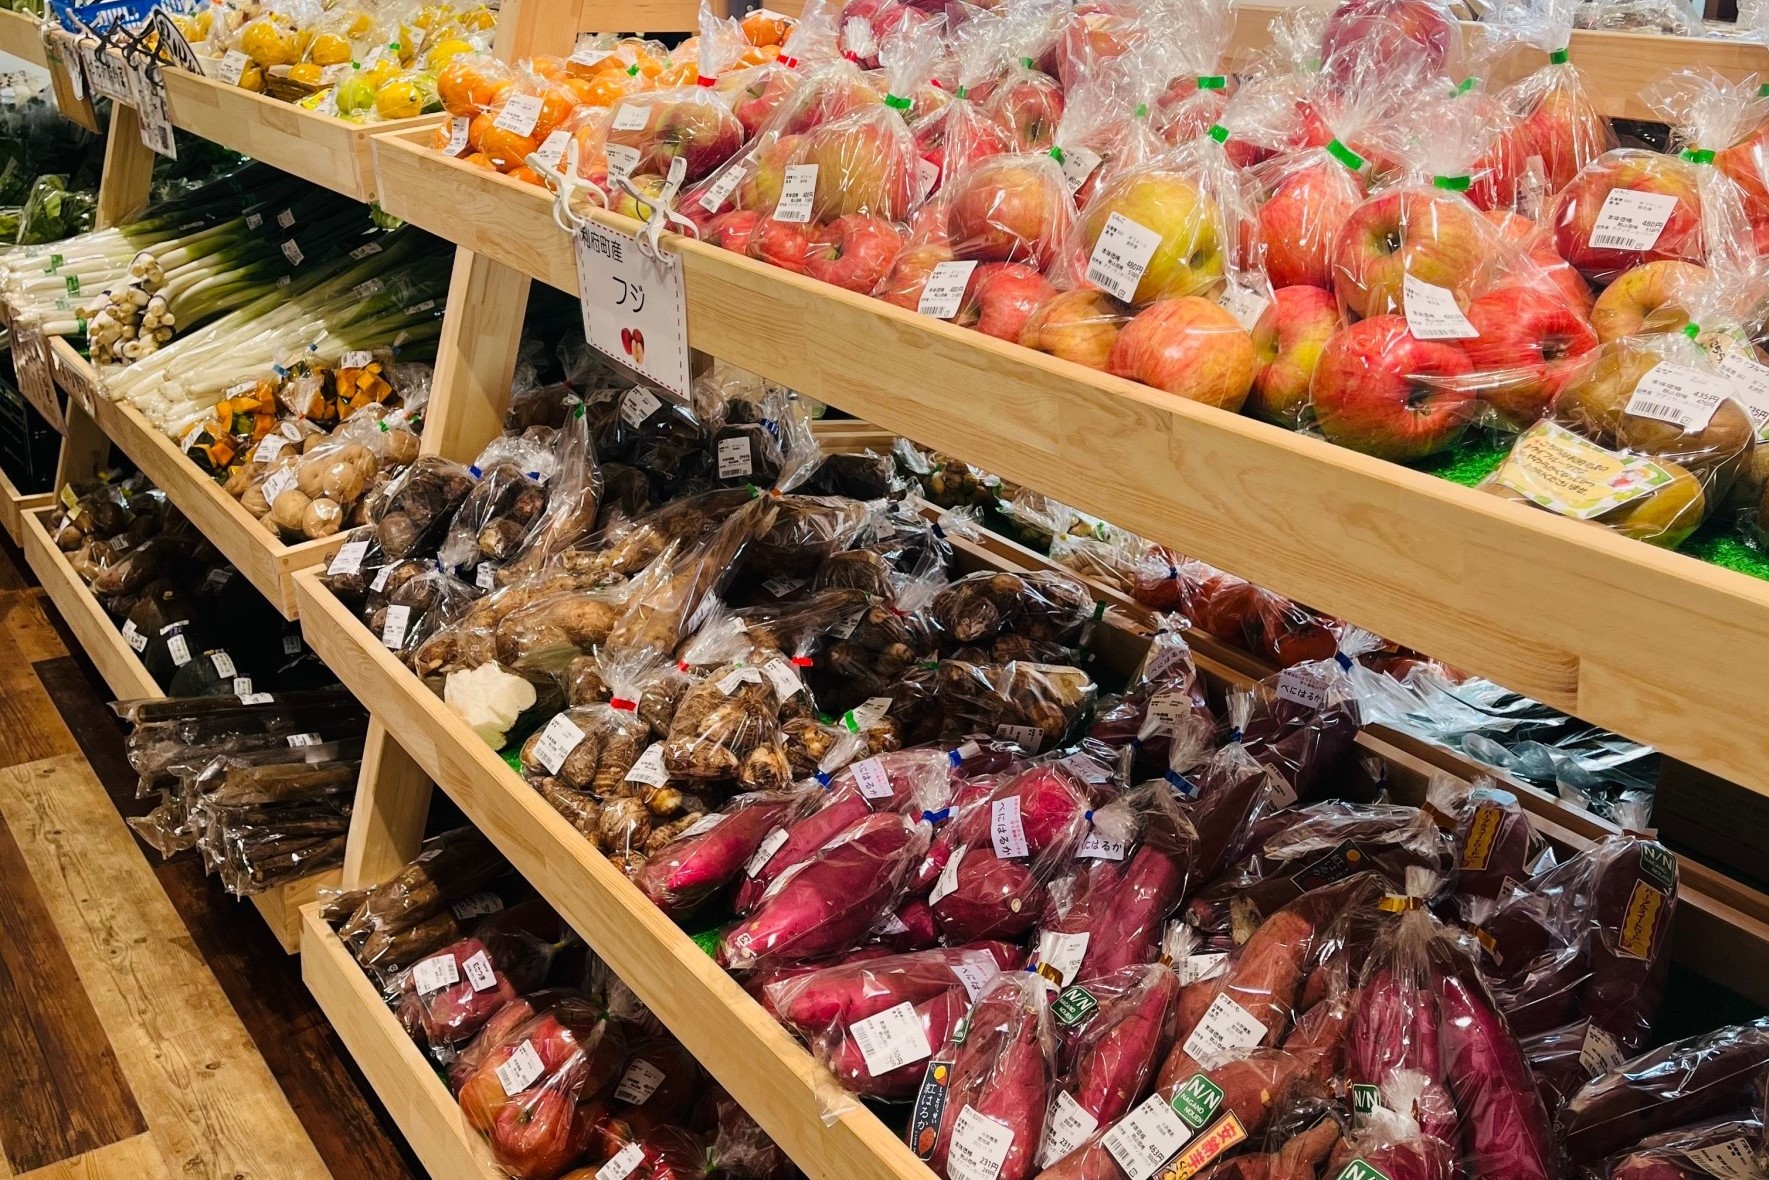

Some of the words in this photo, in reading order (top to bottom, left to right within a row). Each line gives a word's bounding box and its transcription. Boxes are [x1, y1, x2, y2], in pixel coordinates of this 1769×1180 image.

[1642, 220, 1663, 228] 480円
[581, 227, 623, 264] 利府町産
[1127, 260, 1144, 273] 480円
[612, 276, 645, 313] フジ
[1693, 391, 1720, 404] 435円
[1281, 684, 1321, 702] べにはるか
[997, 802, 1012, 856] べにはるか
[1066, 990, 1092, 1011] N/N
[1220, 995, 1240, 1012] さつまいも
[1205, 1024, 1224, 1042] 本体価格
[1188, 1079, 1220, 1109] N/N
[1355, 1090, 1377, 1108] N/N
[918, 1083, 937, 1130] 紅はるか
[1180, 1093, 1204, 1114] NAGANO
[1184, 1106, 1203, 1124] NOUEN
[1149, 1144, 1165, 1162] 463円
[1187, 1122, 1237, 1169] 安納芋
[980, 1157, 999, 1172] 231円
